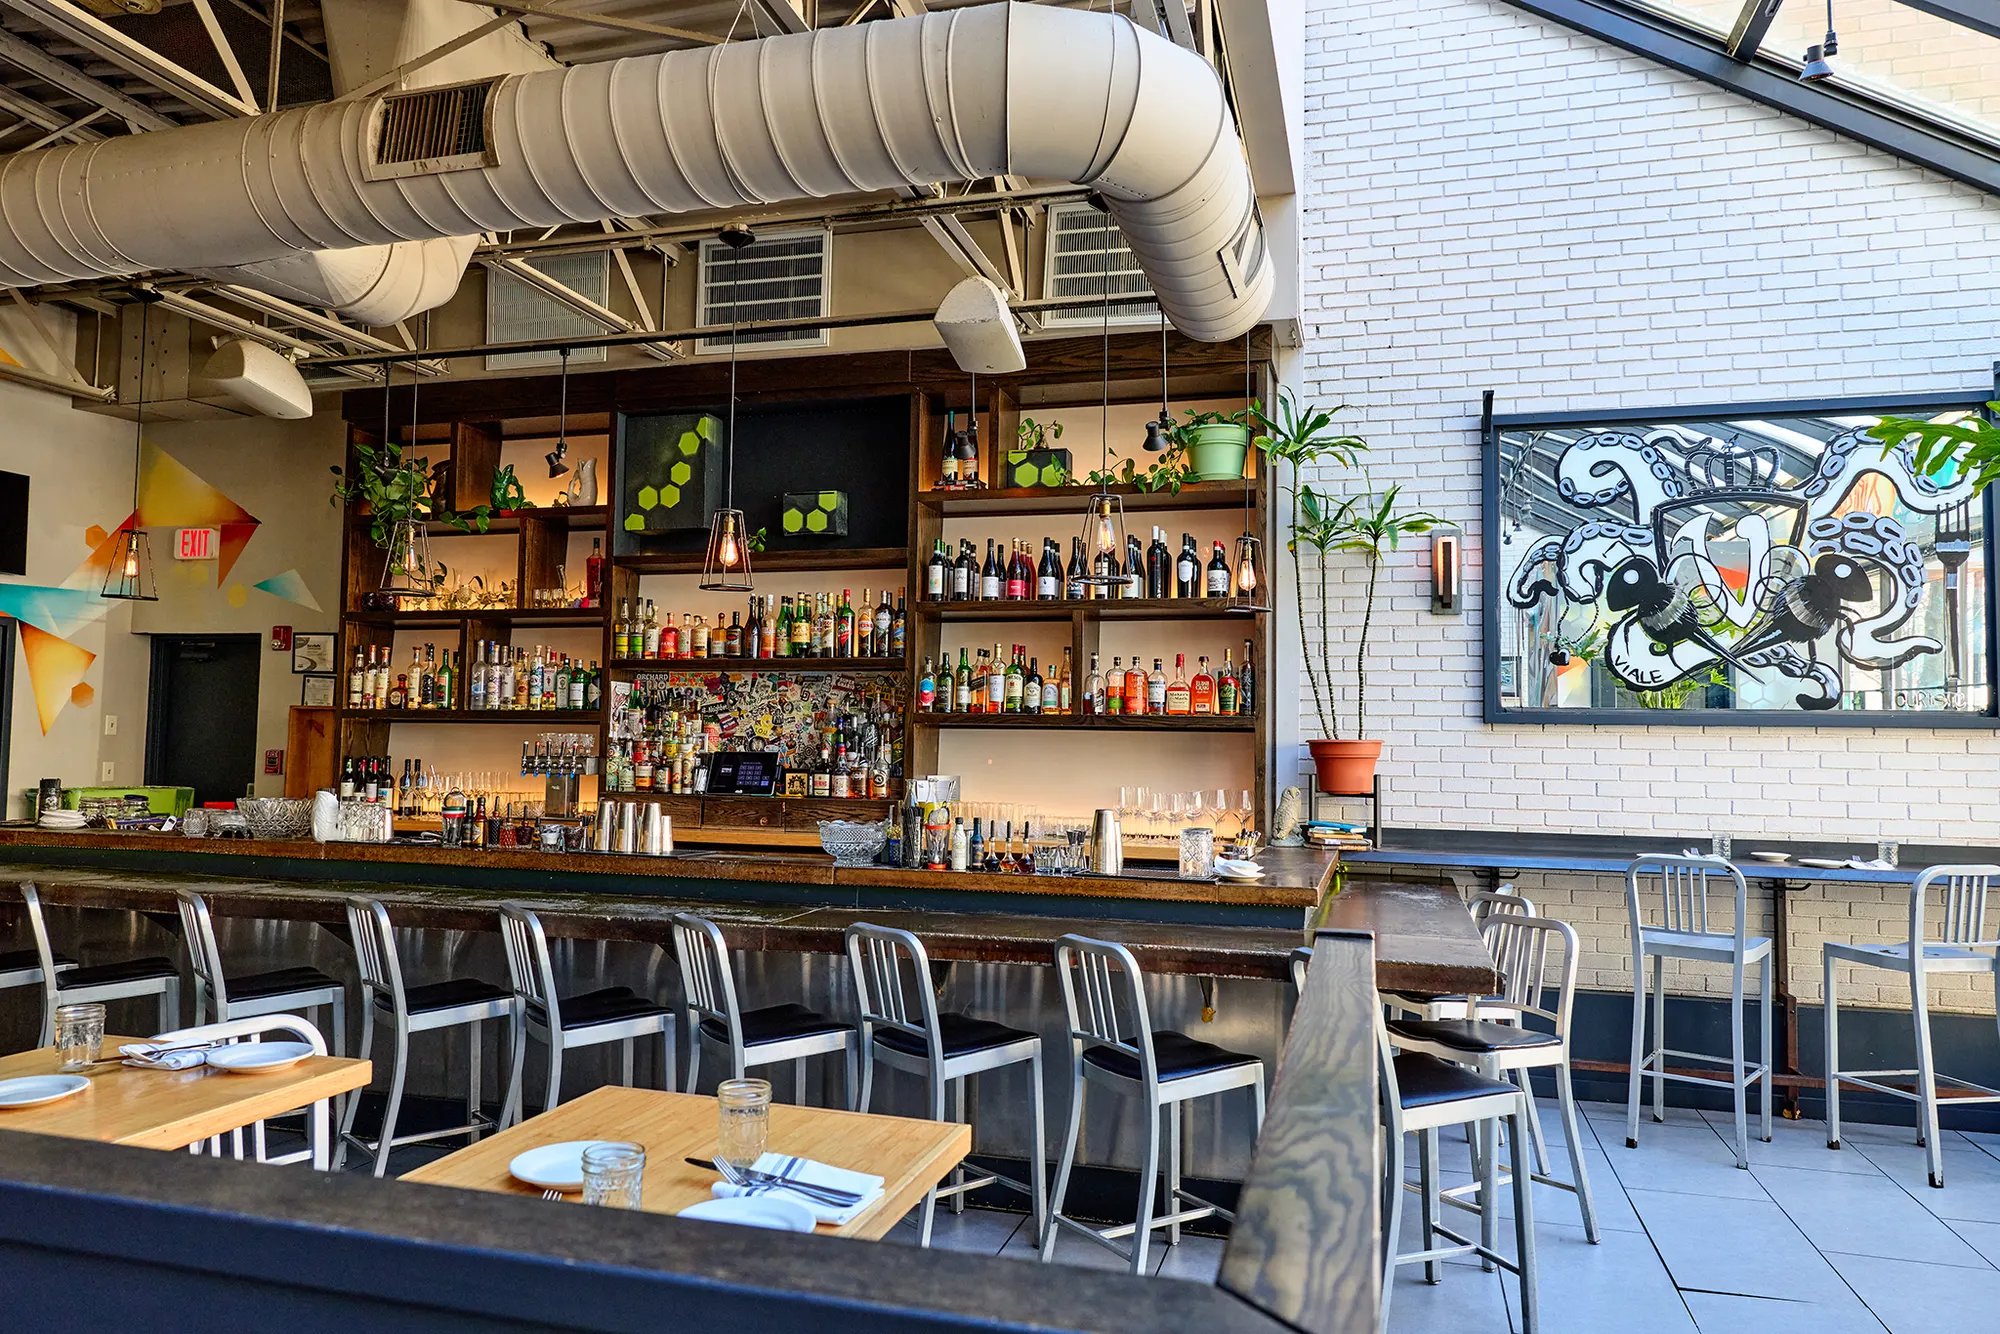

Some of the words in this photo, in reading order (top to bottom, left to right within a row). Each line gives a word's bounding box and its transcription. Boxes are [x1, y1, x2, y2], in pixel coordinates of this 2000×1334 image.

[181, 529, 210, 557] EXIT
[636, 673, 669, 681] ORCHARD
[1615, 654, 1664, 684] VIALE
